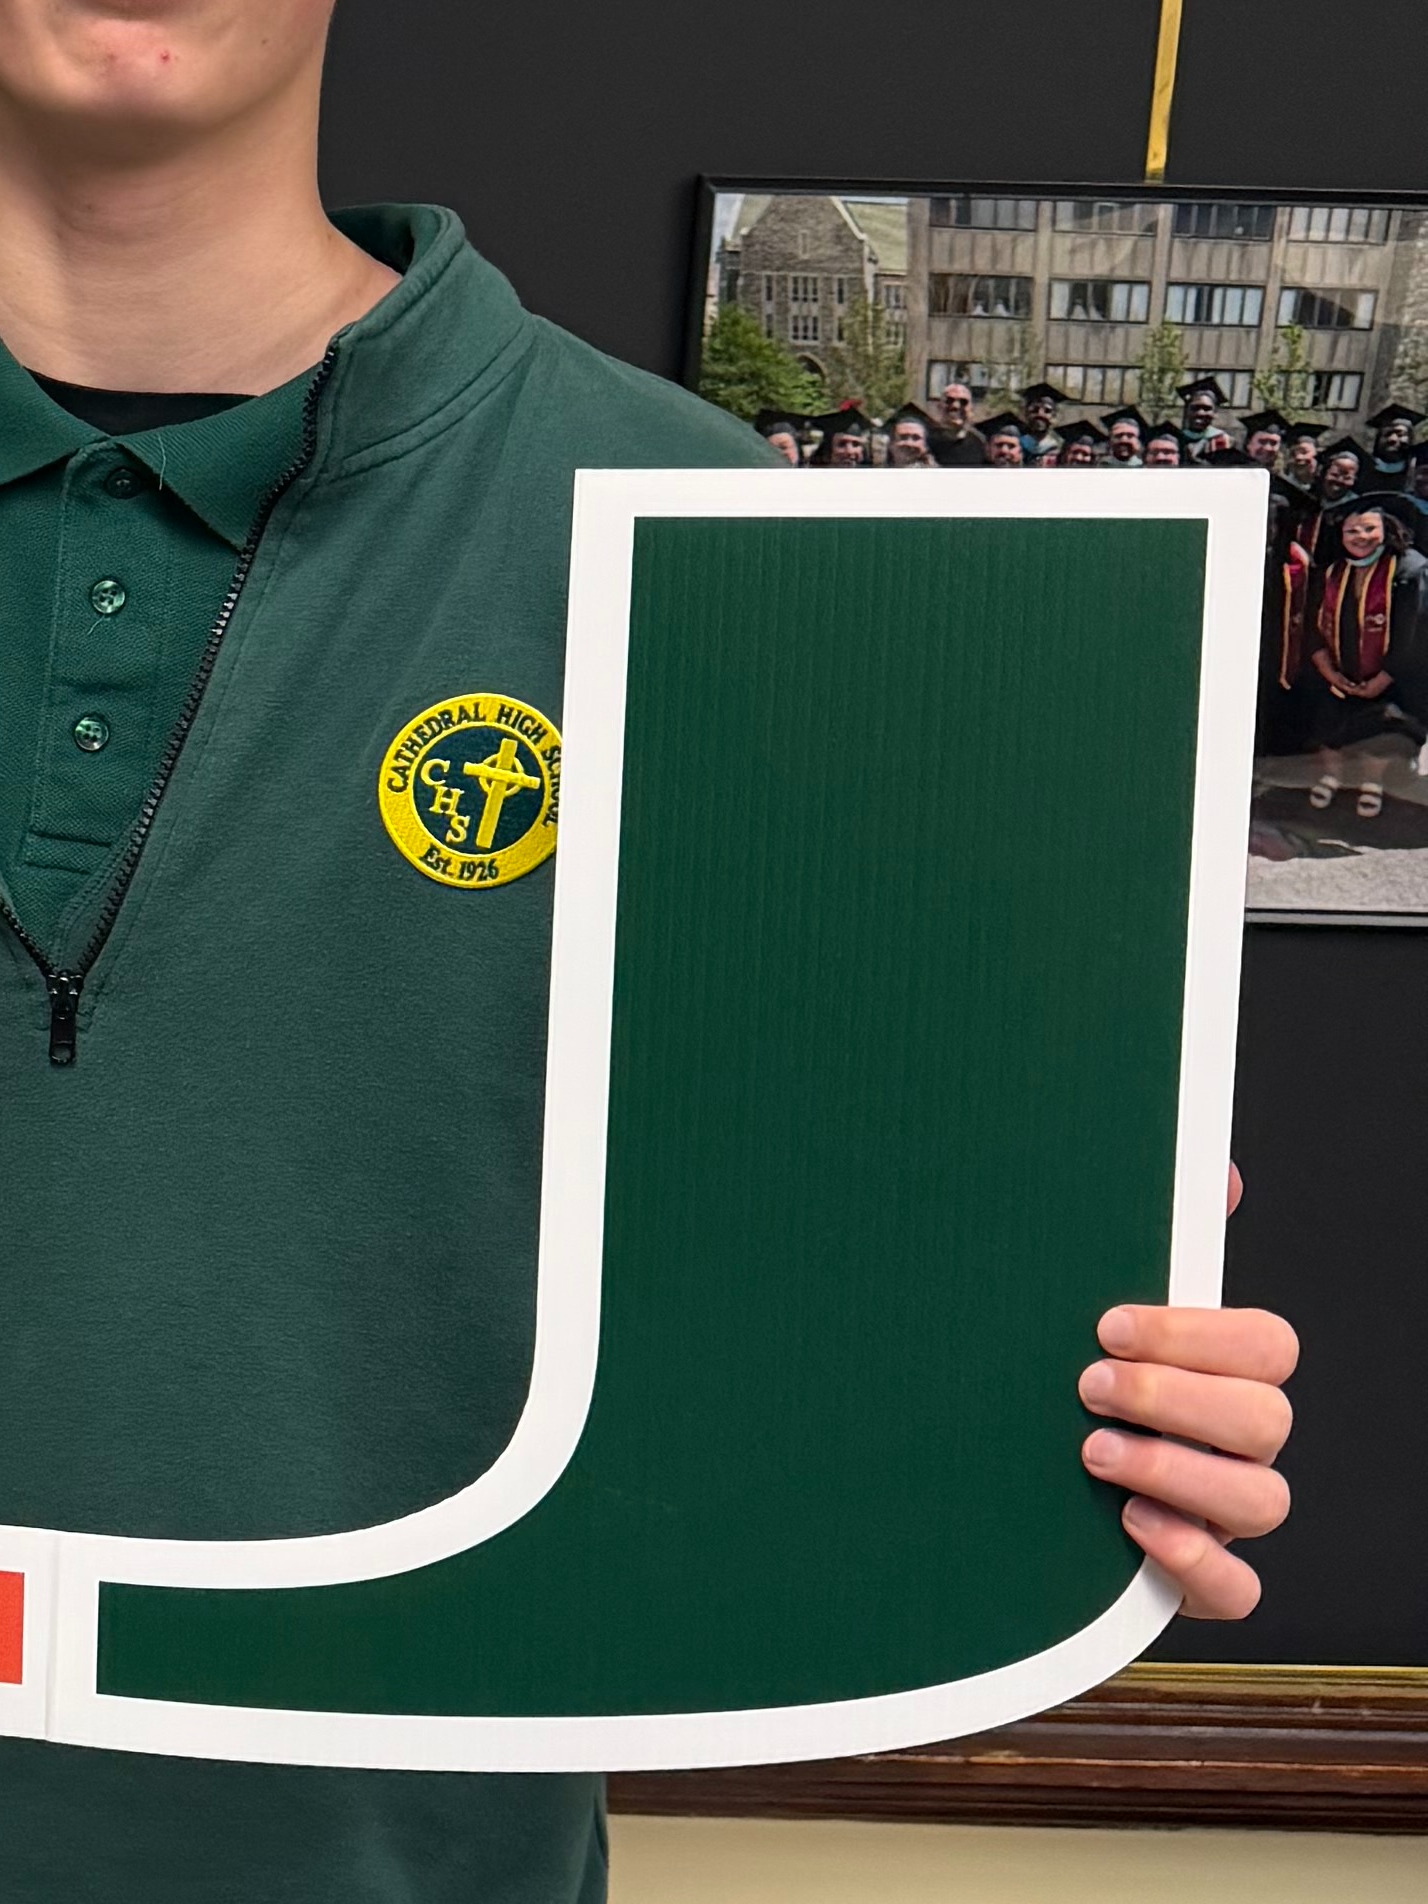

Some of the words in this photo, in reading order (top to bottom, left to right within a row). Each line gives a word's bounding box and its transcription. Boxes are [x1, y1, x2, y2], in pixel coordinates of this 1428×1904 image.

[386, 702, 486, 793] CATHEDRAL
[495, 703, 548, 746] HIGH
[457, 858, 500, 881] 1926
